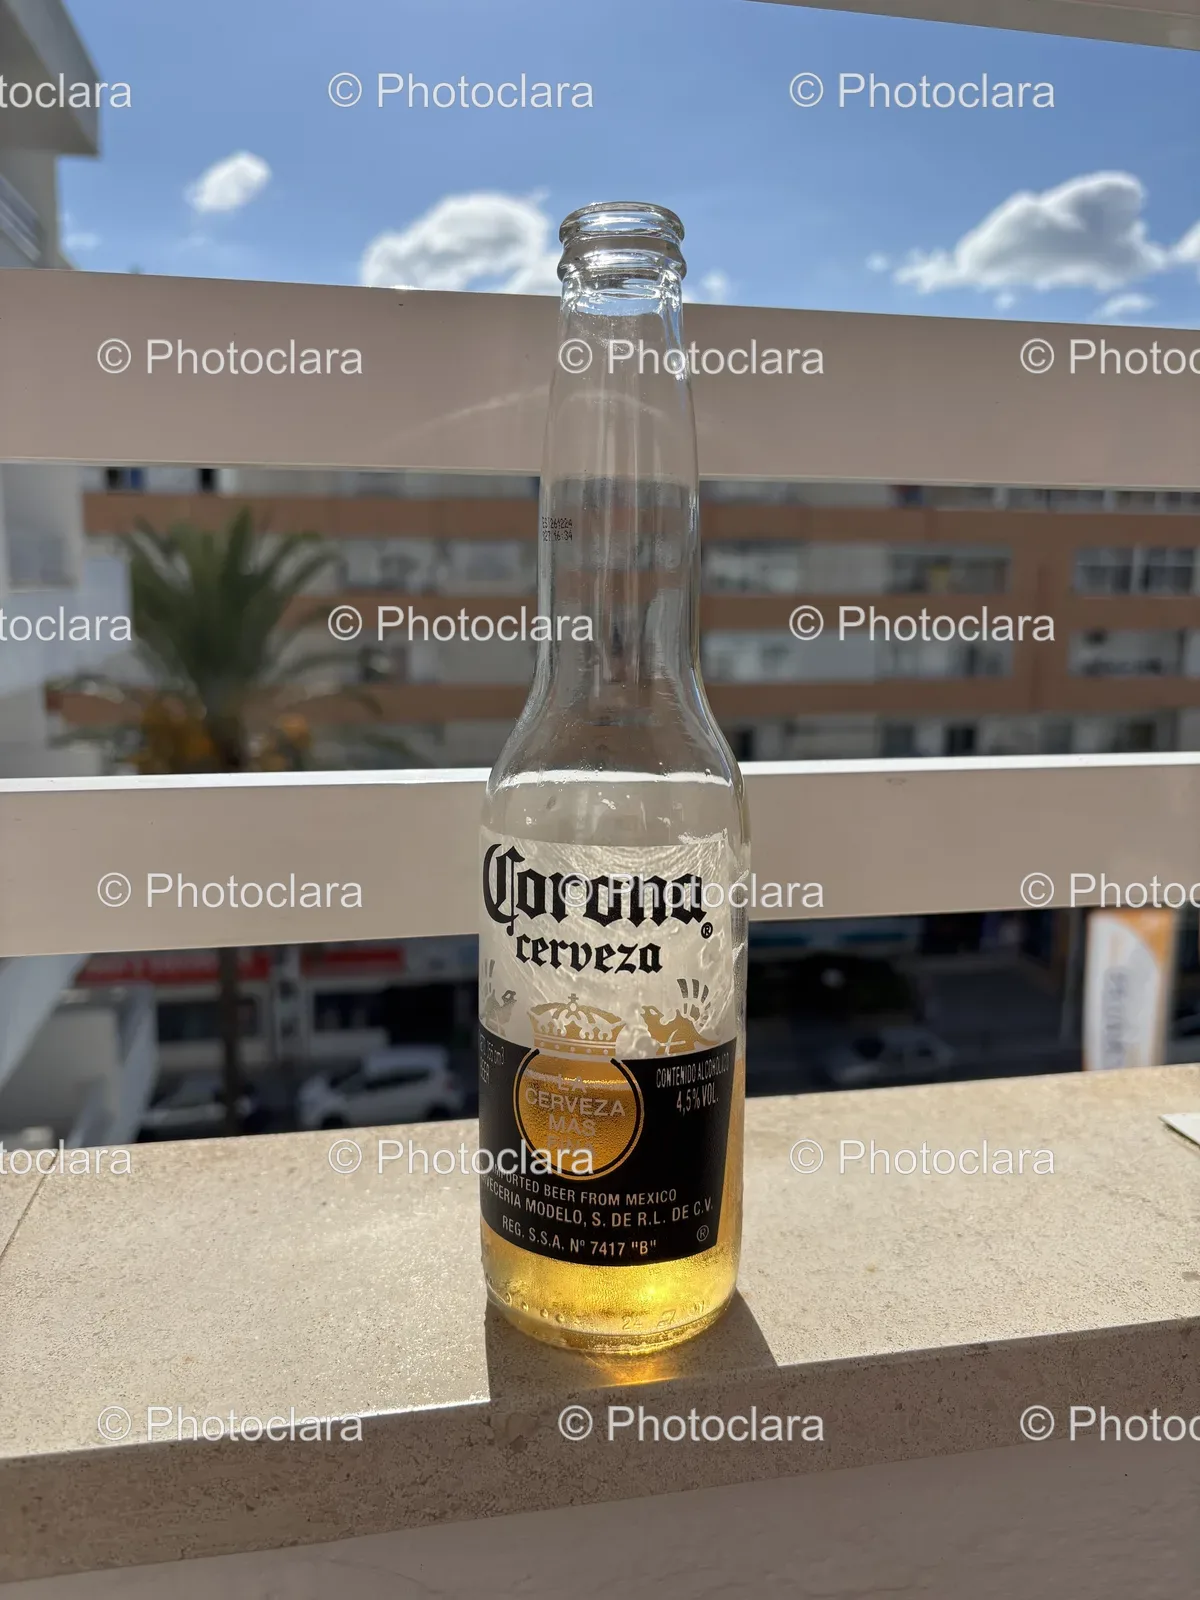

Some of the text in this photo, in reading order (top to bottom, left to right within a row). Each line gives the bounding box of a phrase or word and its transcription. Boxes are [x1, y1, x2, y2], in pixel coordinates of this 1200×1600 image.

[483, 843, 707, 937] Corona
[515, 934, 663, 974] cerveza
[557, 1074, 587, 1093] LA
[656, 1063, 697, 1088] CONTENIDO
[525, 1088, 626, 1117] CERVEZA
[702, 1082, 719, 1107] VOL.
[548, 1114, 596, 1137] MAS
[544, 1184, 575, 1202] BEER
[580, 1191, 620, 1206] FROM
[625, 1188, 677, 1206] MEXICO
[525, 1198, 587, 1227] MODELO,
[591, 1211, 606, 1227] S.
[611, 1212, 632, 1227] DE
[637, 1210, 666, 1226] R.L.
[672, 1204, 689, 1222] DE
[693, 1196, 713, 1216] C.V.
[502, 1215, 525, 1238] REG.
[529, 1227, 565, 1250] S.S.A.
[590, 1241, 626, 1256] 7417
[631, 1239, 657, 1255] "B"
